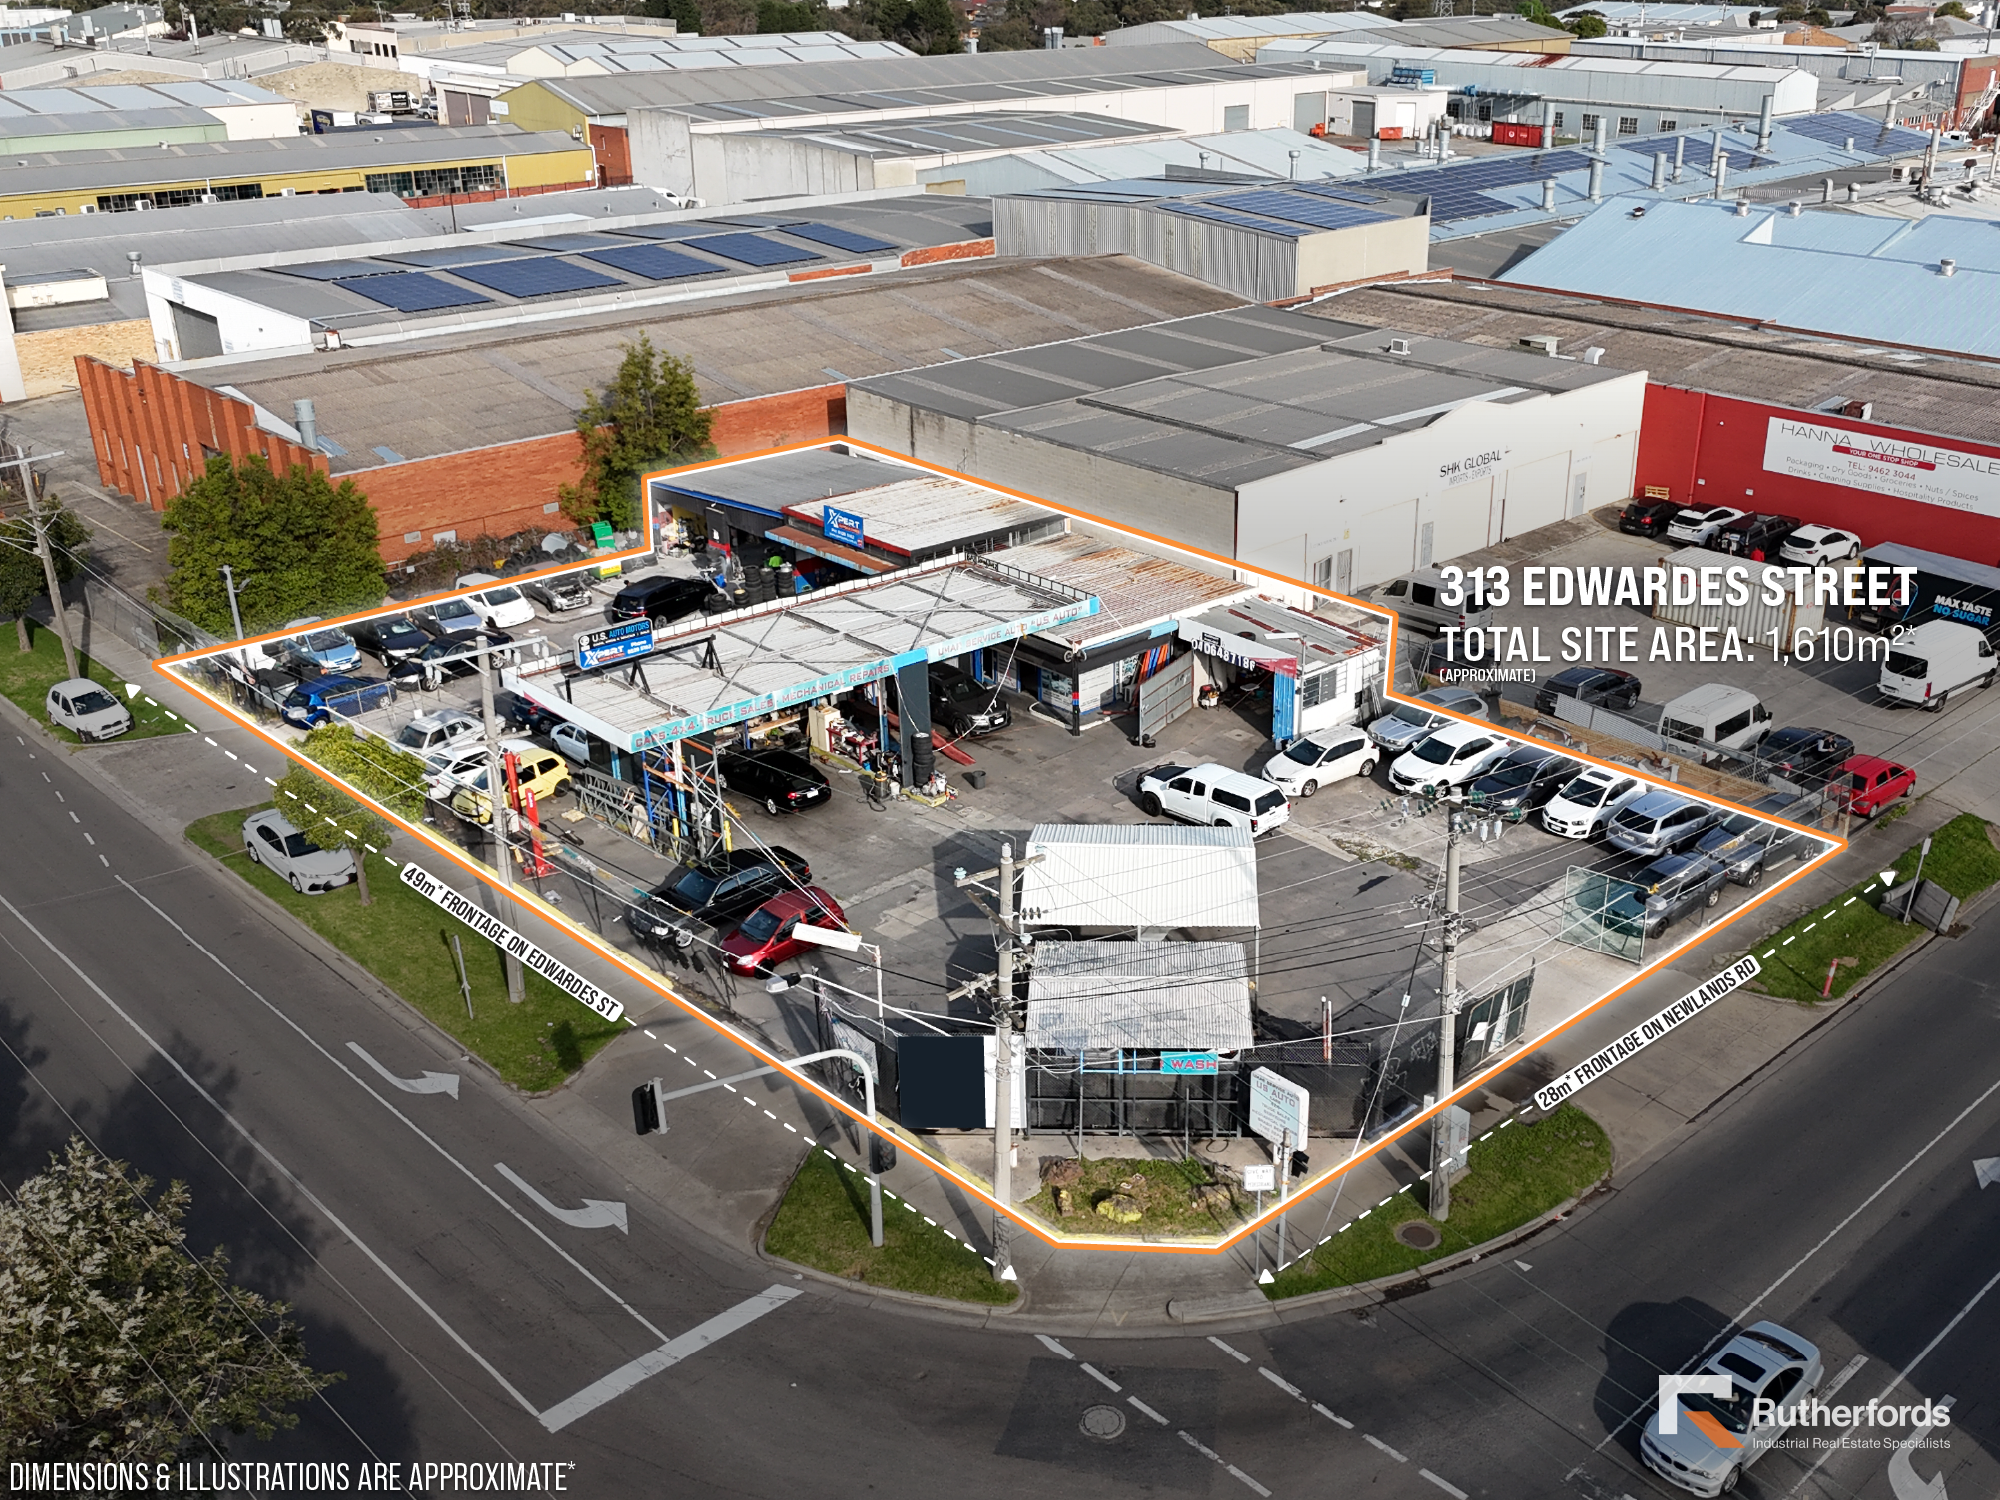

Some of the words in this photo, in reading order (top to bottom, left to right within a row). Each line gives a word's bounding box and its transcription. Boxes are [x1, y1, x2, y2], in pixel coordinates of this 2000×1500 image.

[1781, 423, 1852, 447] HANNA
[1870, 439, 2000, 476] WHOLESALE
[1850, 449, 1867, 458] YOUR
[1867, 452, 1882, 461] ONE
[1883, 455, 1899, 464] STOP
[1900, 458, 1919, 468] SHOP
[1439, 460, 1461, 478] SHK
[1464, 450, 1502, 470] GLOBAL
[1847, 460, 1867, 472] TEL:
[1868, 464, 1891, 477] 9462
[1893, 469, 1917, 482] 3044
[1449, 471, 1469, 487] IMPORTS
[1471, 465, 1493, 481] EXPORTS
[1786, 456, 1825, 472] Packaging
[1831, 465, 1846, 477] Dry
[1847, 469, 1872, 481] Goods
[1880, 475, 1917, 490] Groceries
[1925, 484, 1944, 495] Nuts
[1952, 489, 1979, 503] Spices
[1787, 465, 1812, 478] Drinks
[1818, 472, 1852, 486] Cleaning
[1853, 478, 1886, 493] Supplies
[1893, 486, 1936, 503] Hospitality
[1937, 496, 1975, 511] Products
[826, 508, 861, 530] XPERT
[1933, 604, 1951, 616] NO
[1952, 607, 1991, 626] SUGAR
[1935, 594, 1961, 610] MAX
[1961, 600, 1993, 618] TASTE
[592, 631, 608, 643] U.S.
[608, 627, 625, 639] AUTO
[625, 621, 650, 634] MOTORS
[966, 631, 1002, 648] SERVICE
[584, 645, 625, 667] XPERT
[740, 698, 774, 716] SALES
[782, 678, 847, 703] MECHANICAL
[849, 664, 890, 683] REPAIRS
[1171, 1058, 1218, 1071] WASH
[1256, 1081, 1269, 1093] US
[1271, 1089, 1296, 1108] AUTO
